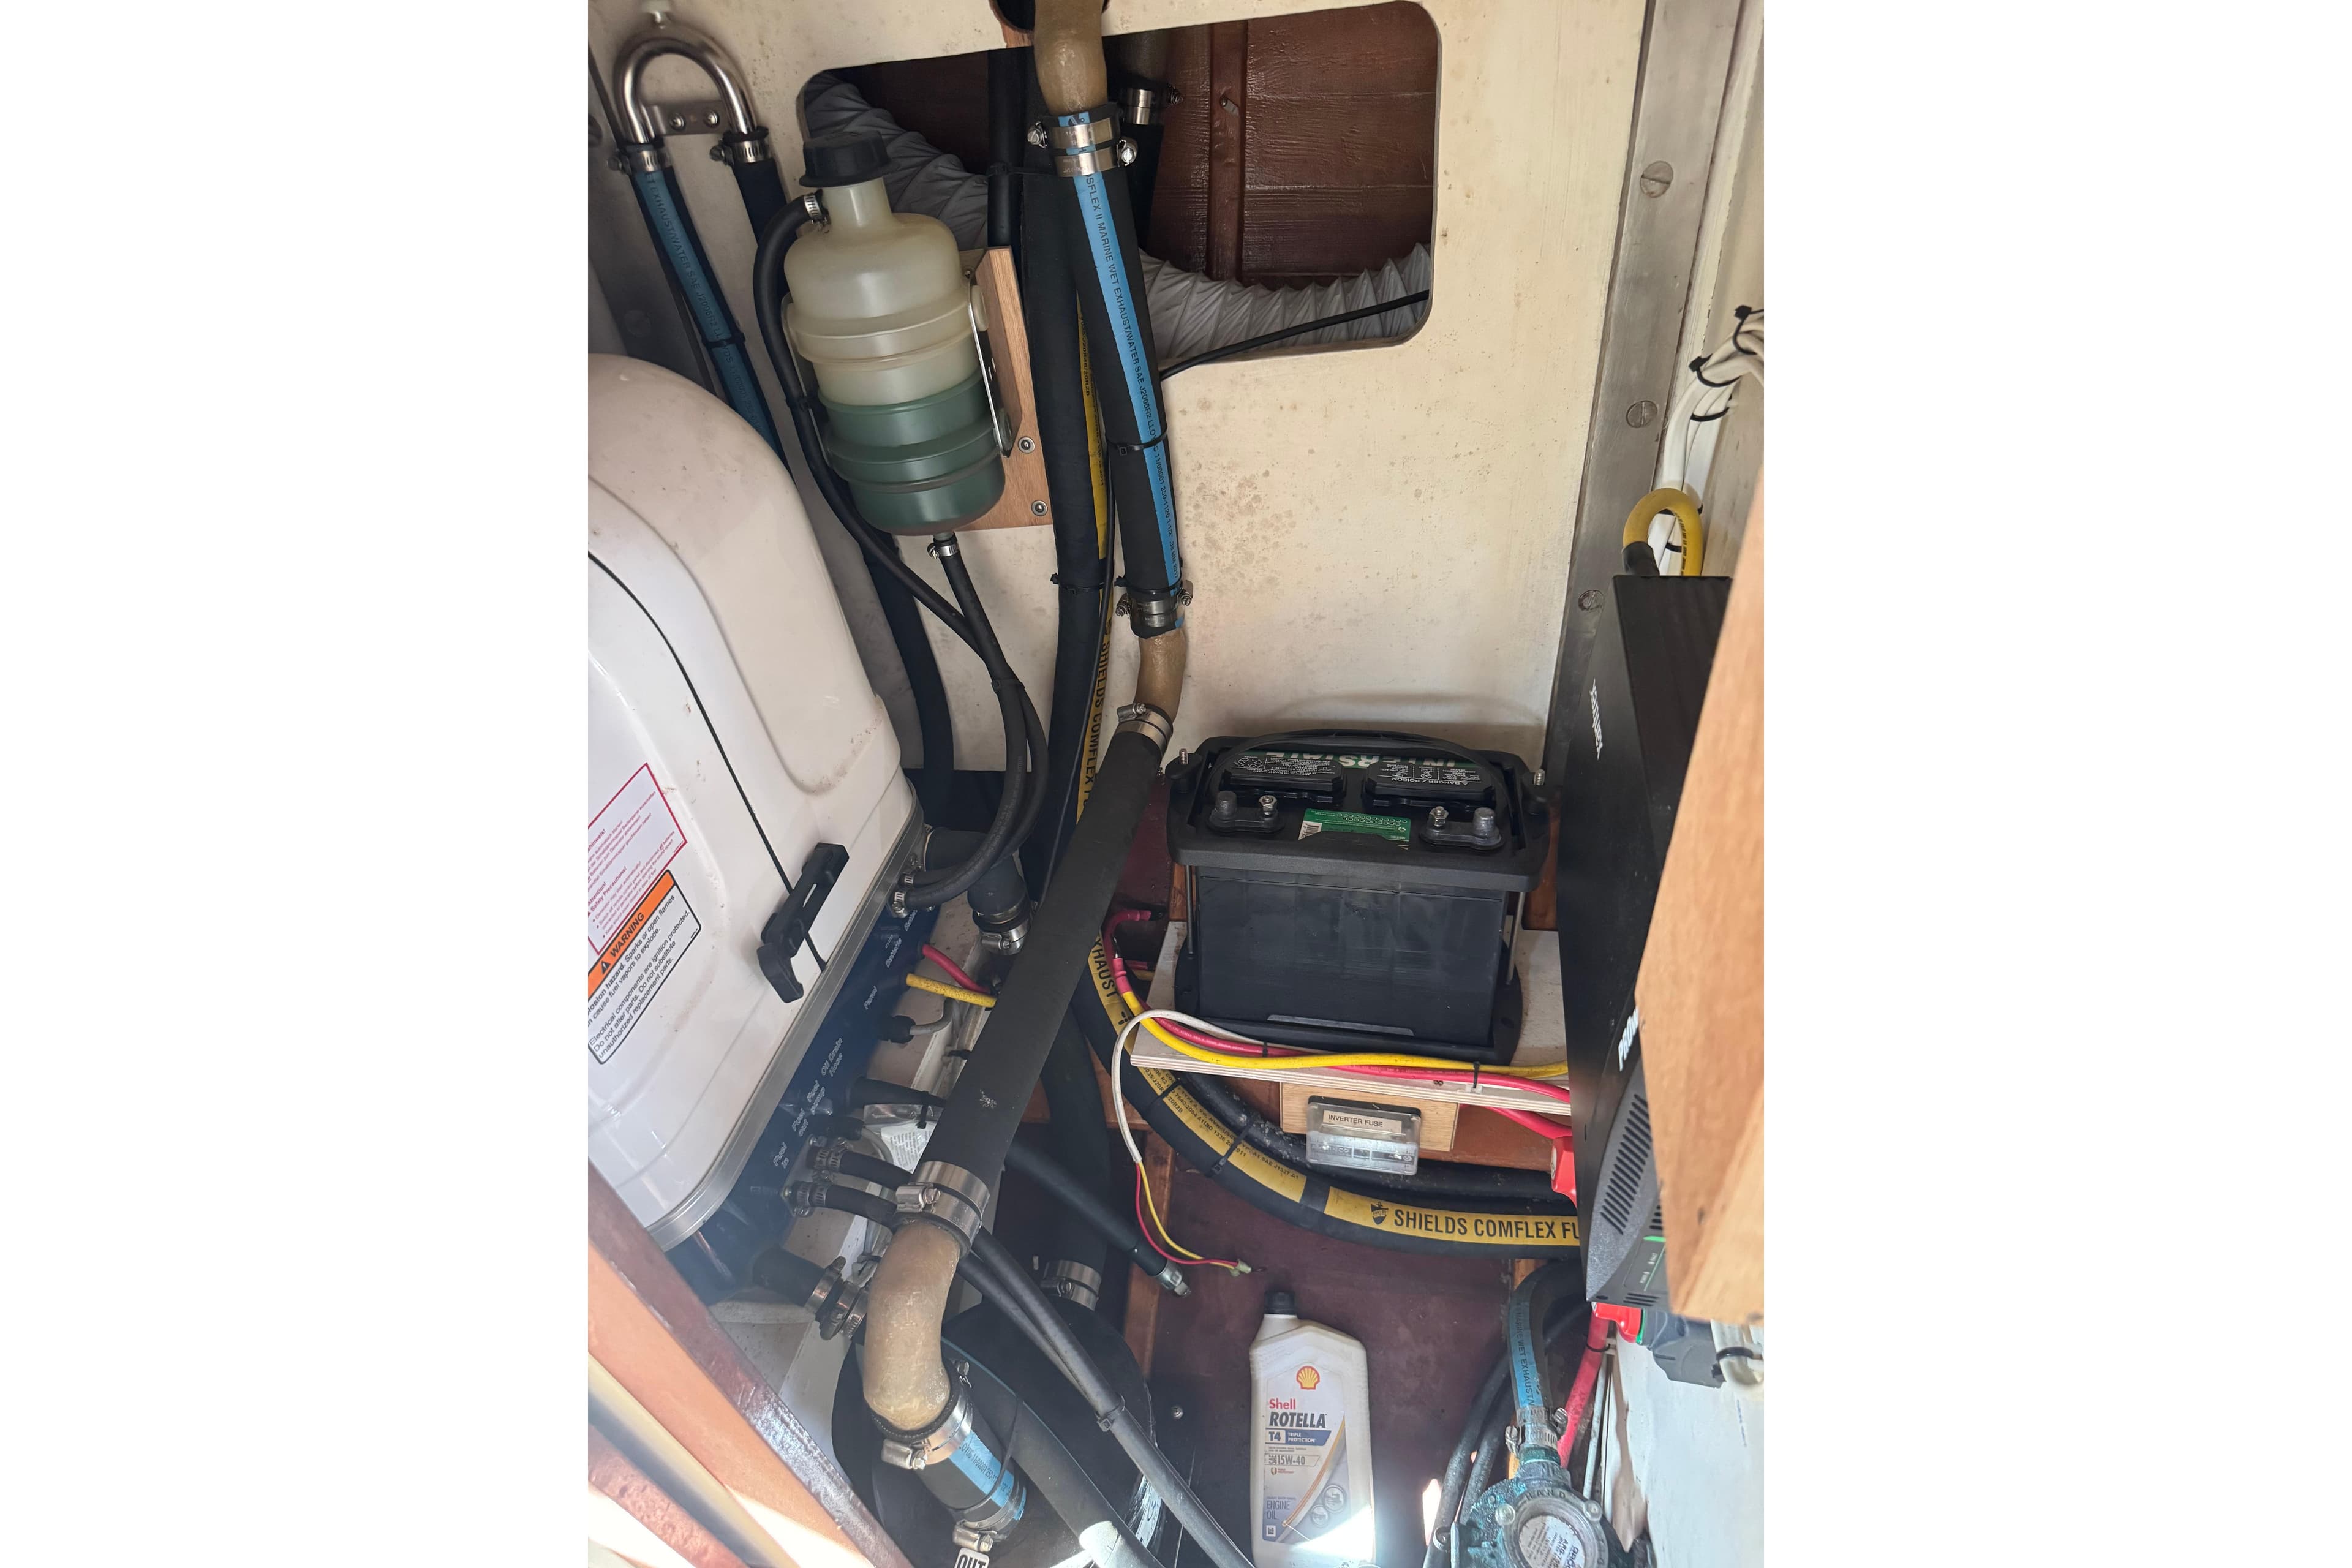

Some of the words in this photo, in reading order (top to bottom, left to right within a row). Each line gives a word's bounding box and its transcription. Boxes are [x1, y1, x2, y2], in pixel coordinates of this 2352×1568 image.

[644, 172, 654, 184] ET
[687, 270, 701, 289] SAE
[1096, 222, 1114, 262] MARINE
[1107, 263, 1120, 285] WET
[1113, 287, 1140, 365] EXHAUST/WATER
[1134, 366, 1145, 384] SAE
[1138, 385, 1153, 418] J2006R2
[1146, 419, 1162, 451] LLOYS
[1084, 714, 1102, 783] COMFLEX
[590, 894, 605, 913] Safety
[603, 865, 627, 897] Precautions!
[605, 960, 625, 989] hazard.
[624, 937, 642, 963] Sparks
[641, 929, 648, 940] or
[646, 913, 660, 932] open
[658, 894, 675, 916] flames
[611, 911, 644, 957] WARNING
[589, 1011, 615, 1046] Electrical
[613, 972, 644, 1014] components
[643, 961, 652, 974] are
[649, 937, 669, 963] ignition
[666, 908, 690, 941] protected.
[592, 995, 609, 1019] cause
[608, 979, 620, 998] fuel
[617, 959, 636, 984] vapors
[634, 951, 641, 962] to
[639, 925, 660, 954] explode.
[594, 1039, 604, 1052] Do
[603, 1026, 614, 1041] not
[612, 1009, 625, 1029] alter
[623, 991, 639, 1014] parts.
[638, 980, 647, 993] Do
[645, 969, 655, 982] not
[652, 939, 676, 971] substitute
[598, 1011, 633, 1059] unauthorized
[630, 973, 661, 1015] replacement
[658, 955, 673, 976] parts.
[805, 1079, 820, 1102] Fuel
[791, 1107, 806, 1132] Fuel
[1328, 1114, 1362, 1124] INVERTER
[772, 1141, 788, 1166] Fuel
[1393, 1209, 1468, 1235] SHIELDS
[1473, 1218, 1557, 1238] COMFLEX
[1517, 1340, 1526, 1356] WET
[1268, 1397, 1296, 1409] Shell
[1269, 1411, 1327, 1428] ROTELLA
[1268, 1431, 1281, 1441] T4
[1278, 1455, 1306, 1466] 15W-40
[1266, 1500, 1289, 1509] ENGINE
